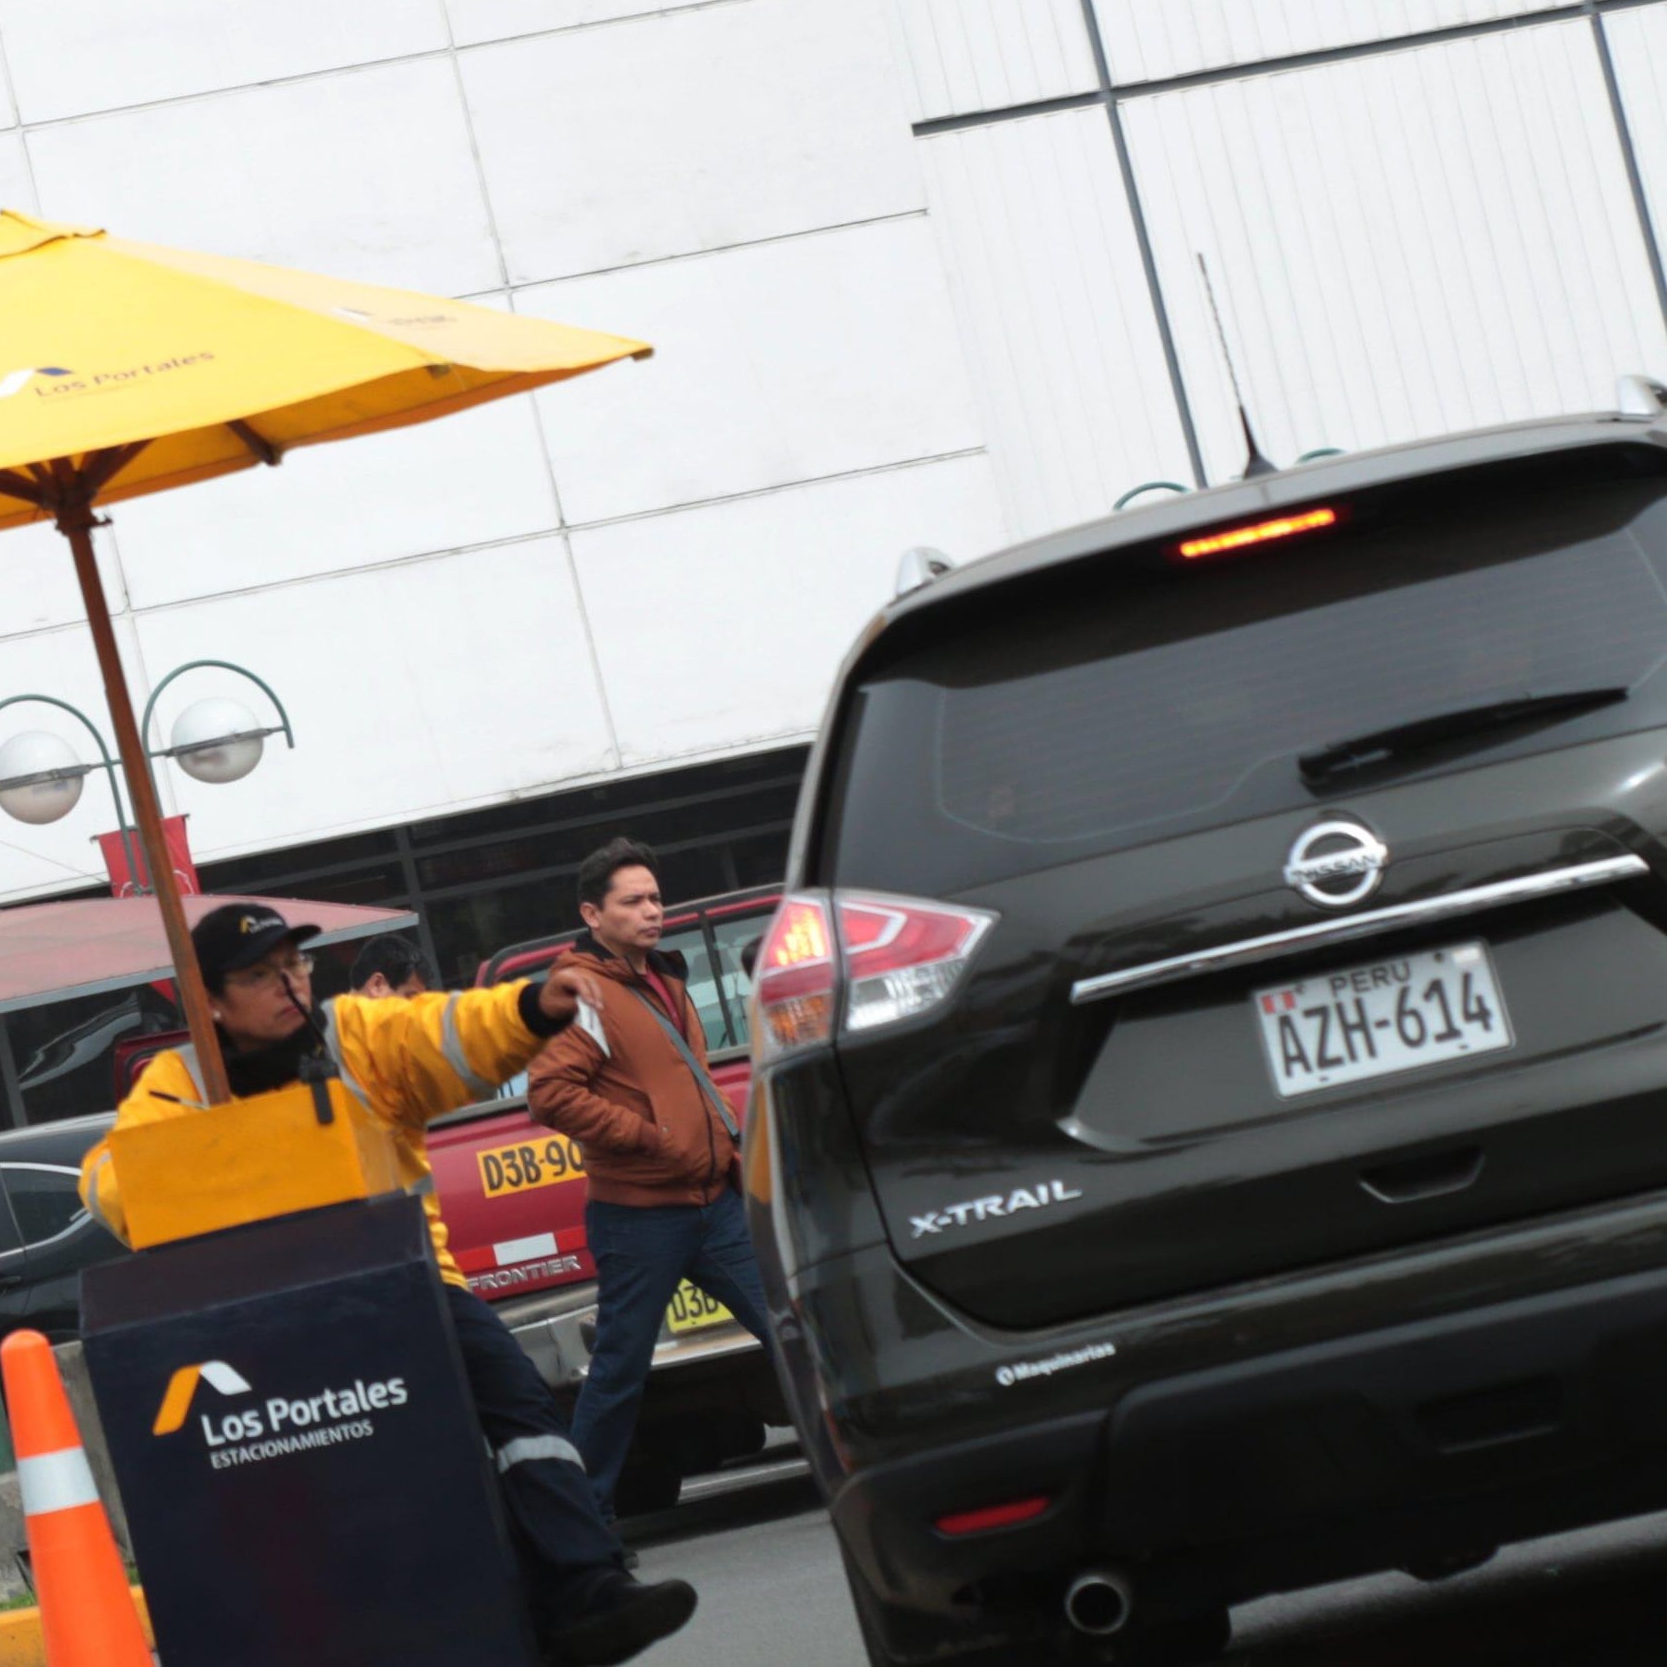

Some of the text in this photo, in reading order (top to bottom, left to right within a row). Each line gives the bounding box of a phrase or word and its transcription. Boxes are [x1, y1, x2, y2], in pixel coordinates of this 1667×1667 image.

[35, 380, 87, 398] Los
[93, 351, 215, 385] Portales
[1291, 853, 1377, 883] NISSAN
[1329, 961, 1411, 998] PERU
[1277, 971, 1492, 1077] AZH-614
[909, 1179, 1083, 1239] X-TRAIL
[466, 1254, 581, 1293] FRONTIER
[200, 1377, 409, 1447] Los Portales
[209, 1418, 375, 1471] ESTACIONAMIENTOS
